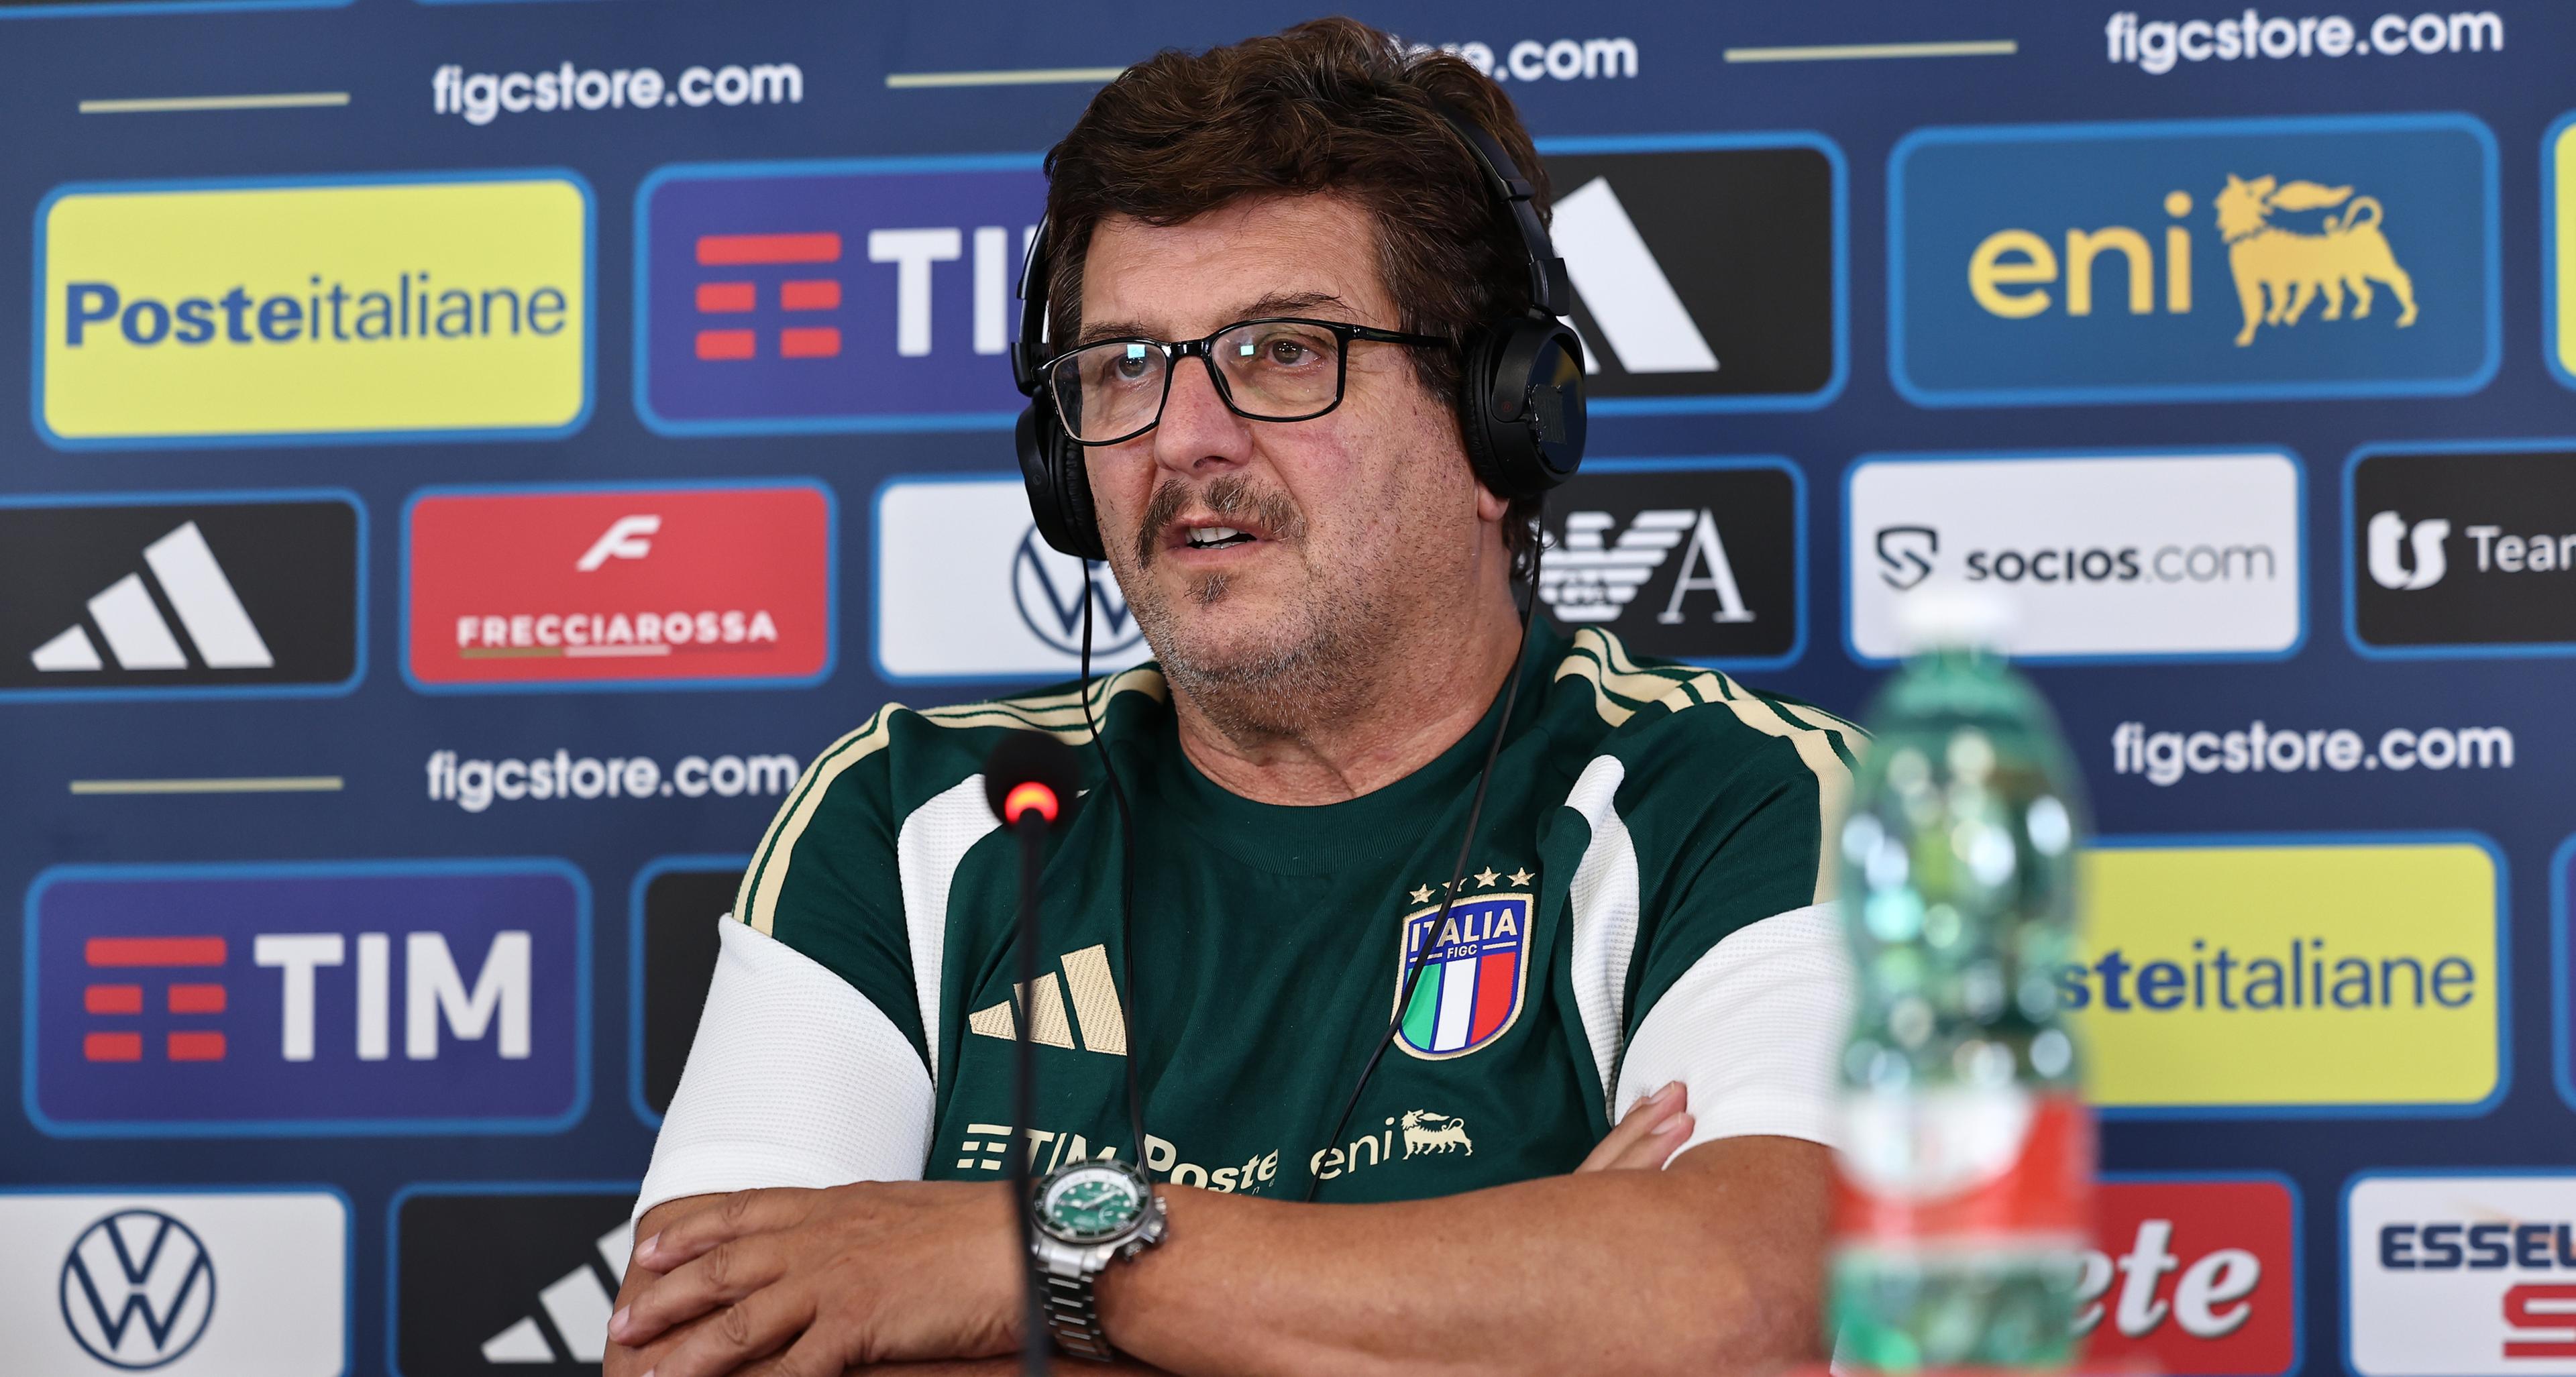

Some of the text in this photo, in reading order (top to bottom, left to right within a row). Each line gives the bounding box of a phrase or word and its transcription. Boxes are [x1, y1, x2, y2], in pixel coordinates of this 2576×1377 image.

[1390, 32, 1639, 82] e.com
[2106, 10, 2503, 74] figcstore.com
[433, 62, 802, 124] figcstore.com
[1968, 190, 2194, 319] eni
[66, 272, 566, 347] Posteitaliane
[868, 225, 1040, 357] TI
[455, 610, 780, 648] FRECCIAROSSA
[427, 749, 800, 812] figcstore.com
[2113, 722, 2513, 785] figcstore.com
[1446, 944, 1478, 959] FIGC
[2054, 938, 2477, 1011] steitaliane
[255, 932, 531, 1060] TIM
[1136, 1134, 1279, 1194] Poste
[1310, 1117, 1395, 1180] eni
[2066, 1219, 2262, 1339] ete
